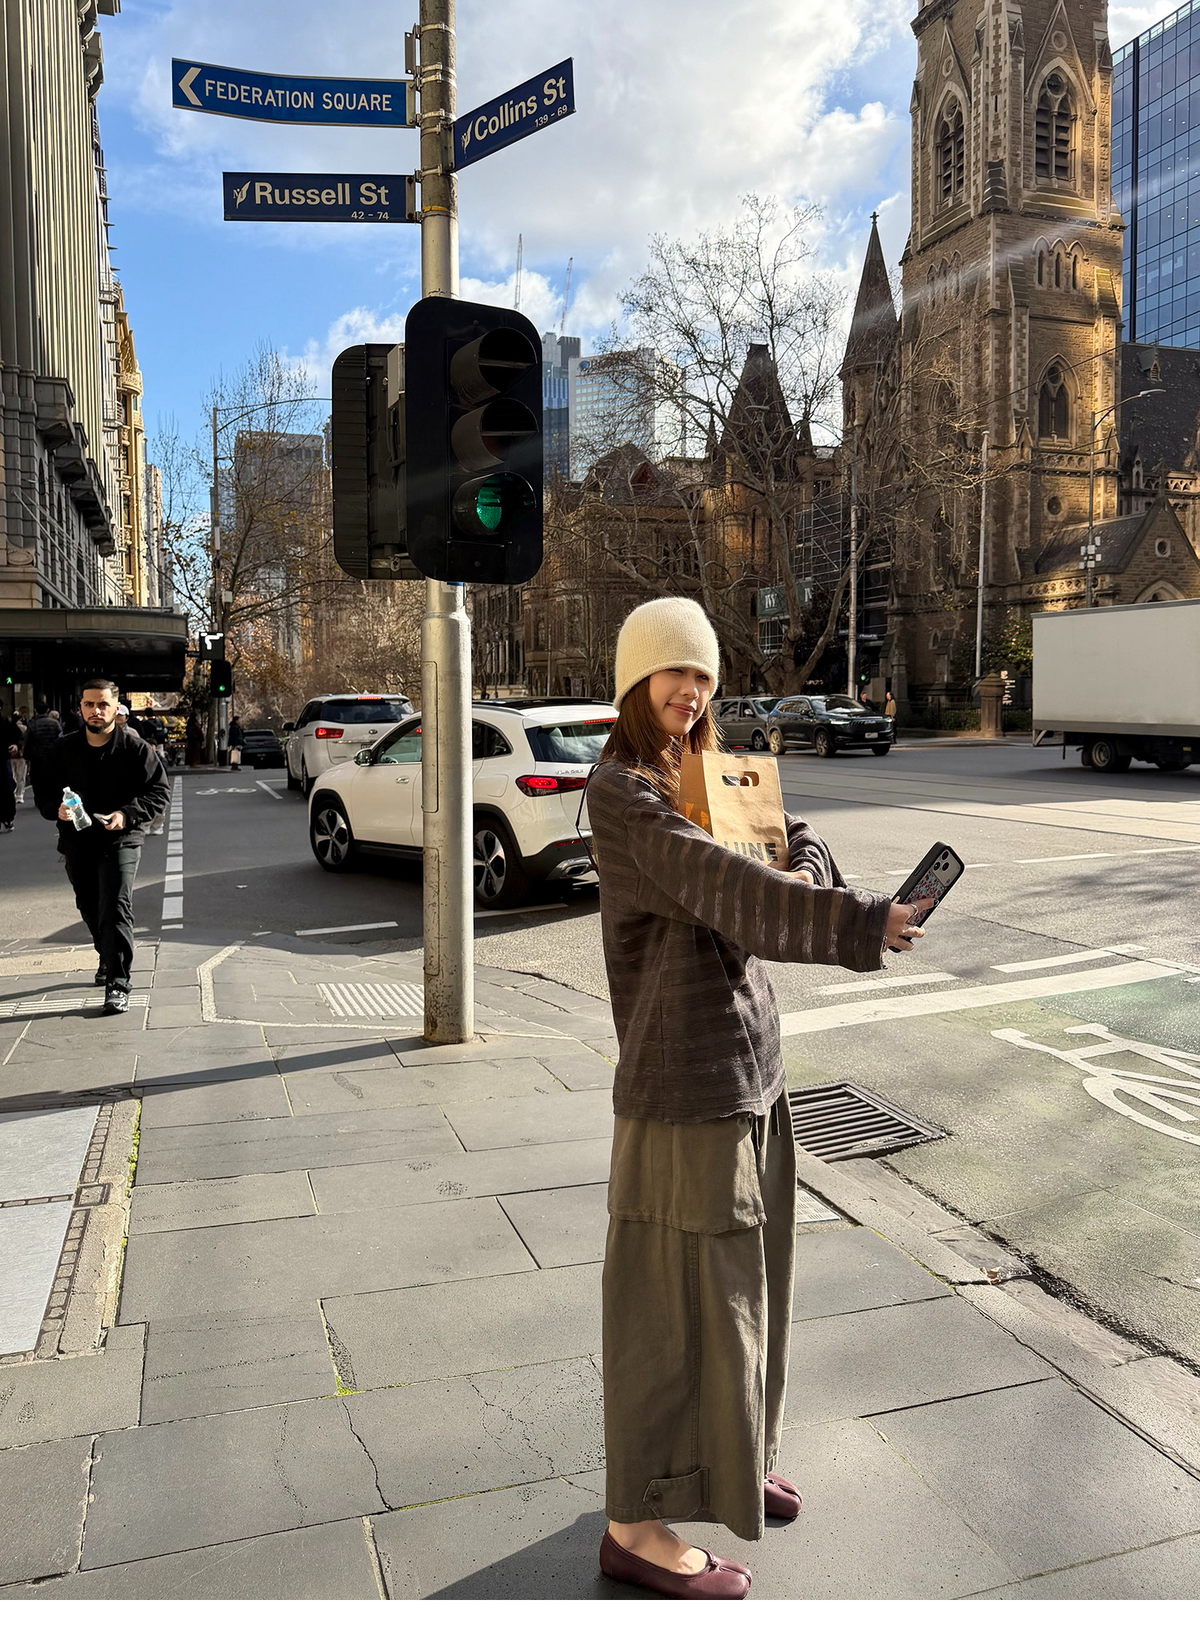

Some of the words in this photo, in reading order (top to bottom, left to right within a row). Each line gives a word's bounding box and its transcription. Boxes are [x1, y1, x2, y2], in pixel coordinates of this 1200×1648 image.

[205, 79, 314, 109] FEDERATION
[322, 92, 392, 111] SQUARE
[474, 95, 538, 141] Collins
[543, 76, 567, 106] St
[534, 114, 549, 128] 139
[557, 104, 568, 117] 69
[254, 182, 351, 205] Russell
[359, 182, 390, 205] St
[351, 210, 365, 220] 42
[377, 211, 389, 220] 74
